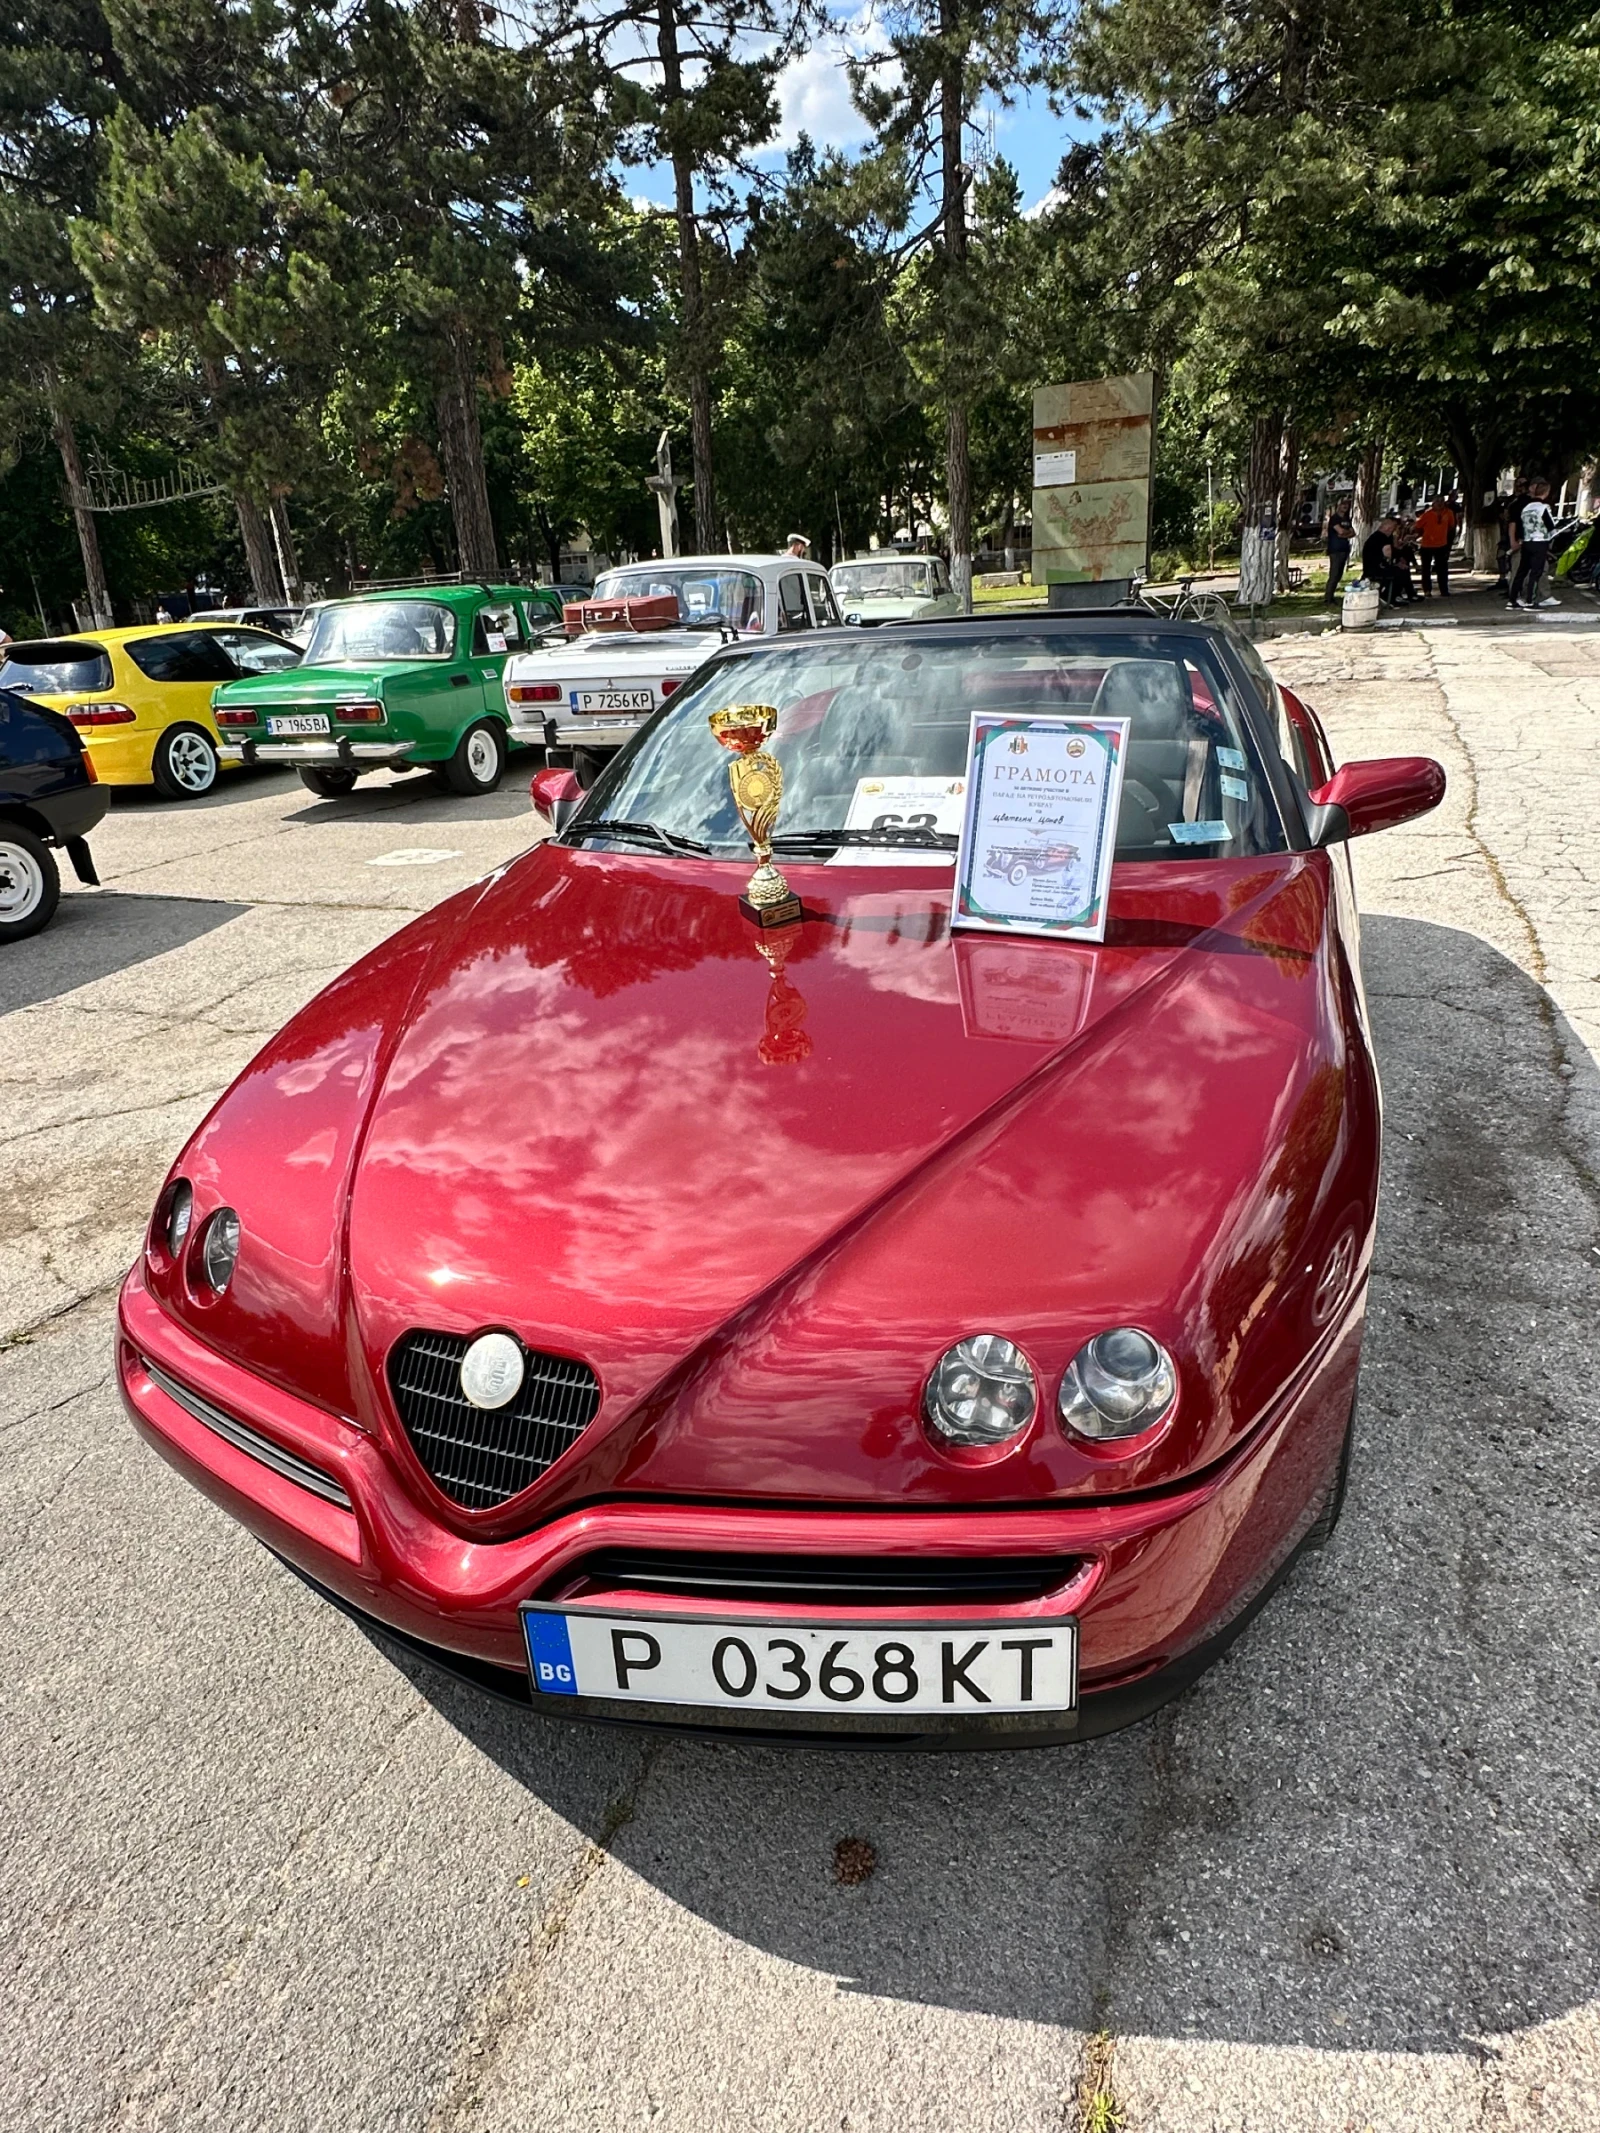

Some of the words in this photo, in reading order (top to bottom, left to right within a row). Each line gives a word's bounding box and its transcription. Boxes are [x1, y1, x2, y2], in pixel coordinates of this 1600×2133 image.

[583, 694, 592, 709] P
[275, 719, 283, 731] P
[994, 766, 1096, 785] ГРАМОТА
[610, 1628, 662, 1690] P
[539, 1662, 571, 1684] BG
